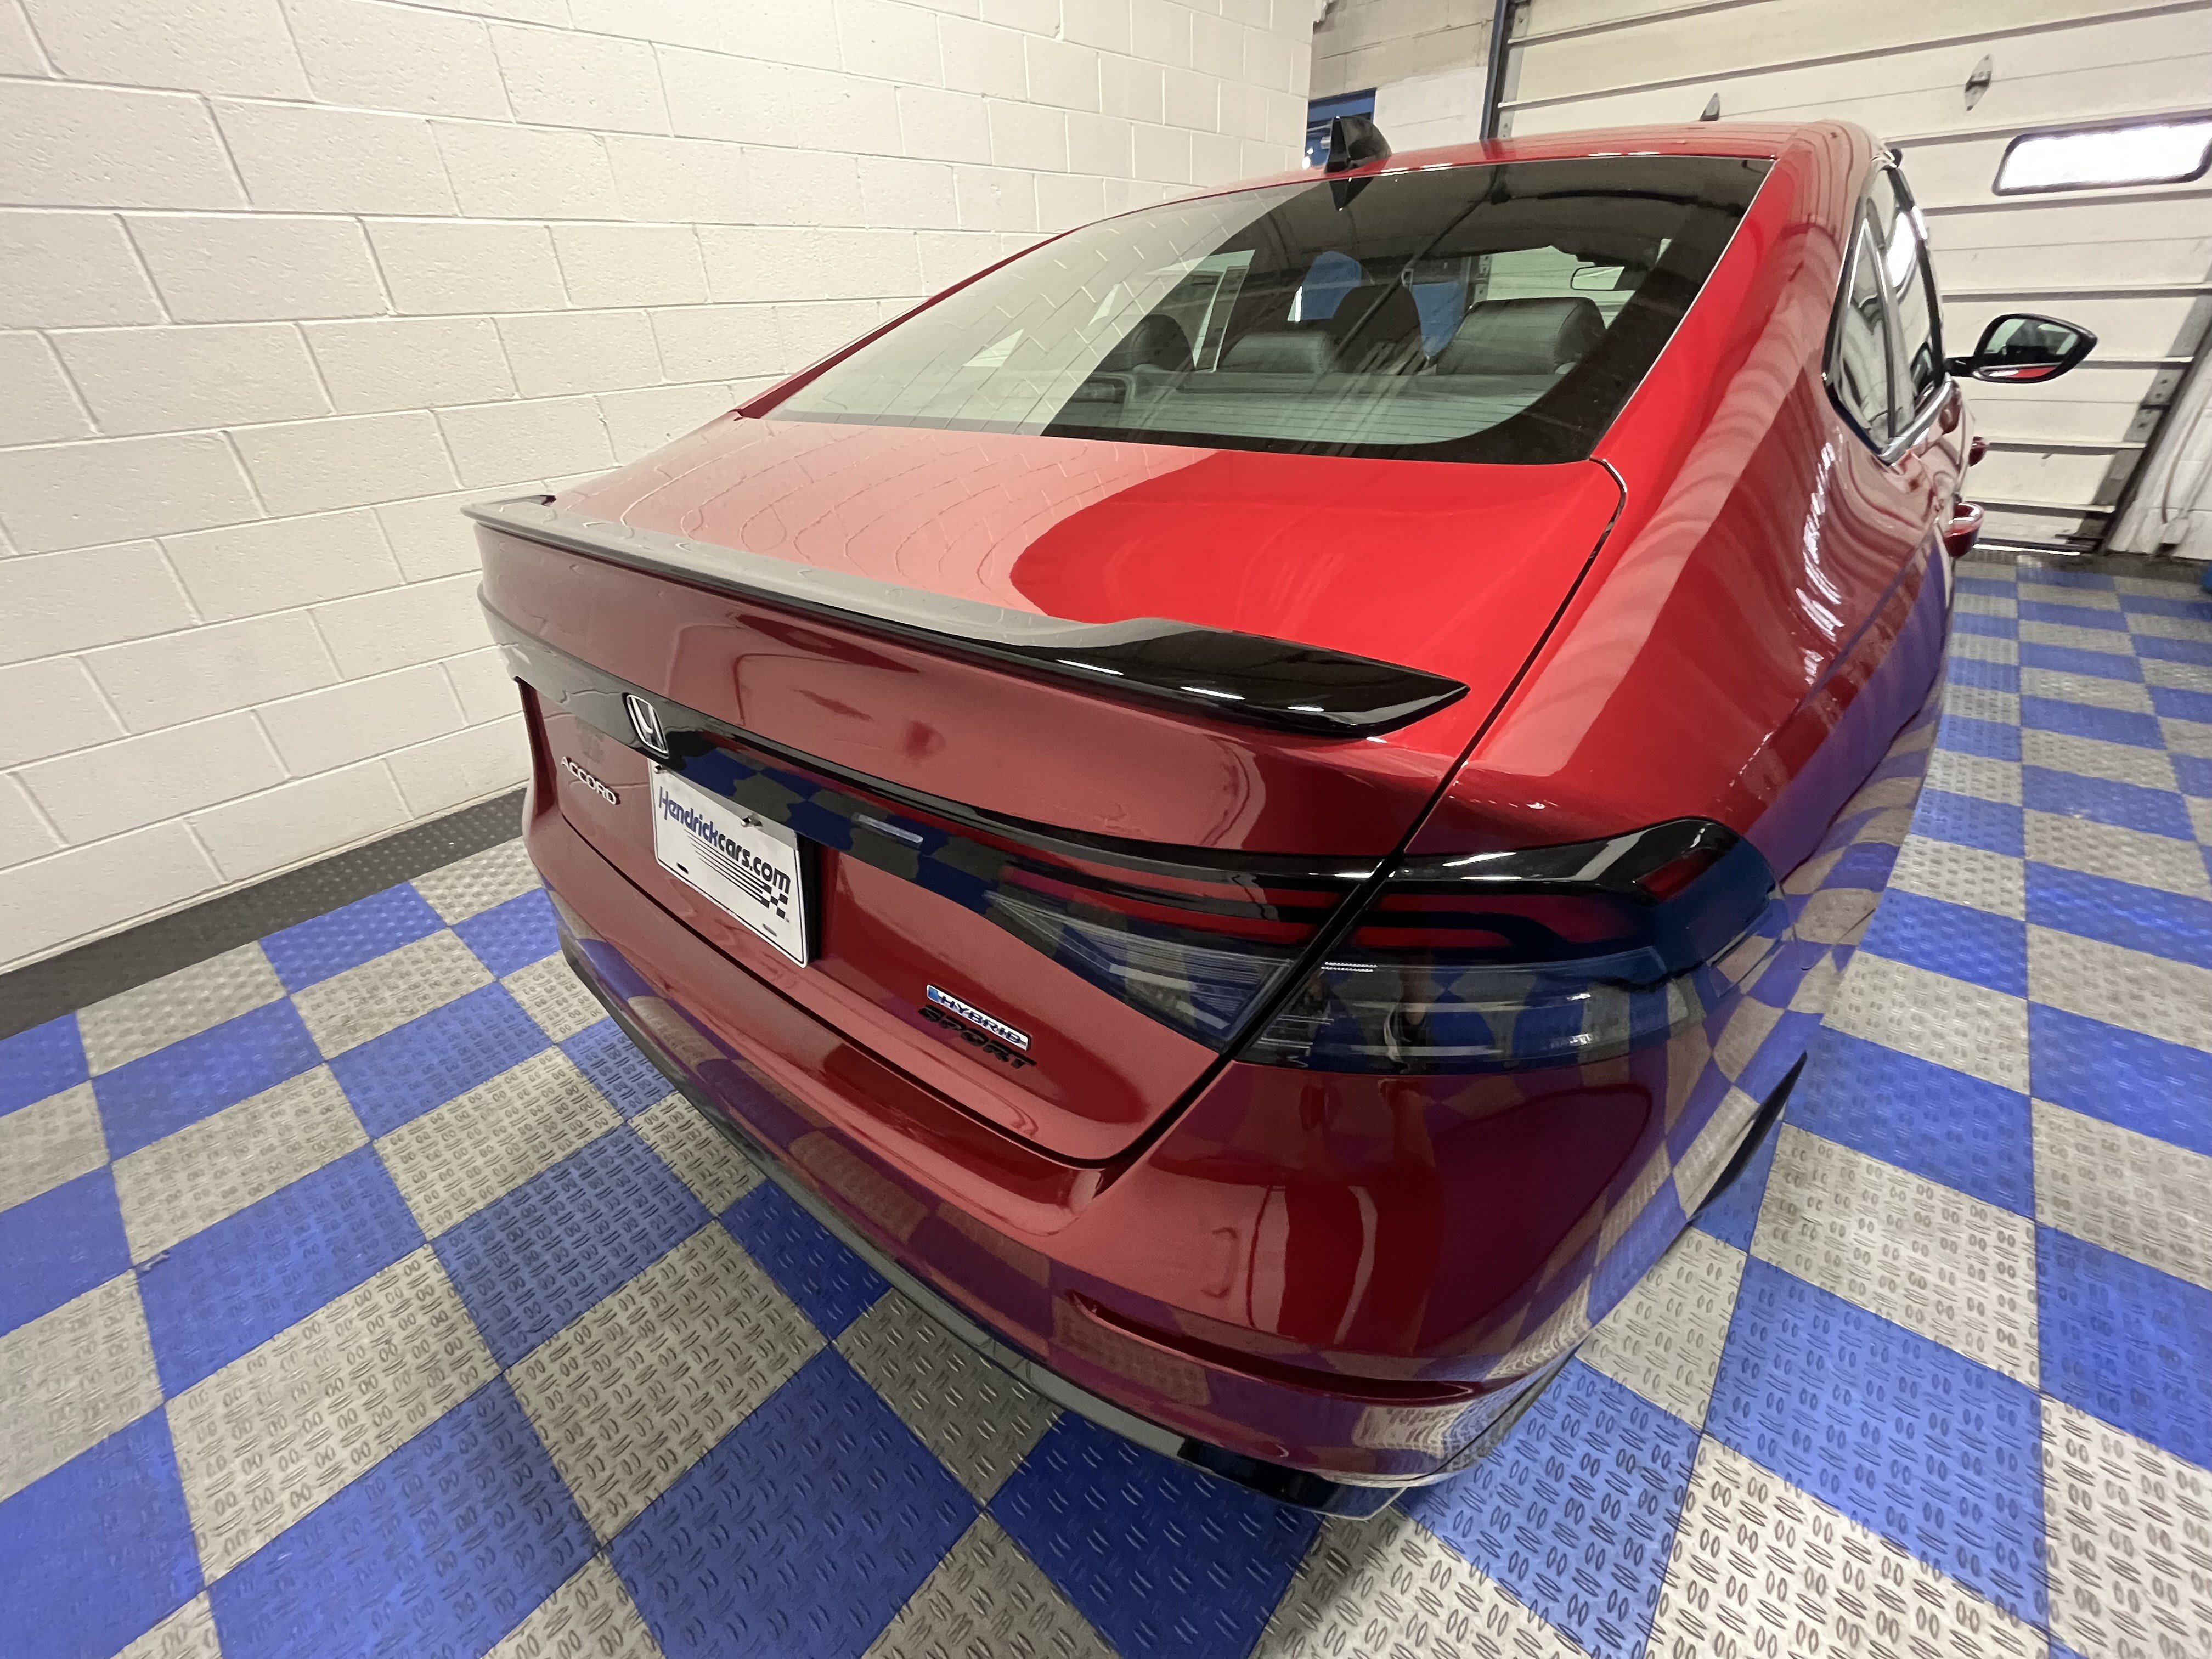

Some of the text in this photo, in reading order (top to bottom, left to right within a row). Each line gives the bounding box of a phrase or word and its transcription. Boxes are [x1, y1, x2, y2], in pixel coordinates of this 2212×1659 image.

[560, 756, 617, 805] ACCORD
[659, 786, 791, 894] Hendrickcars.com
[918, 1005, 1037, 1069] SPORT
[940, 996, 1022, 1044] HYBRID
